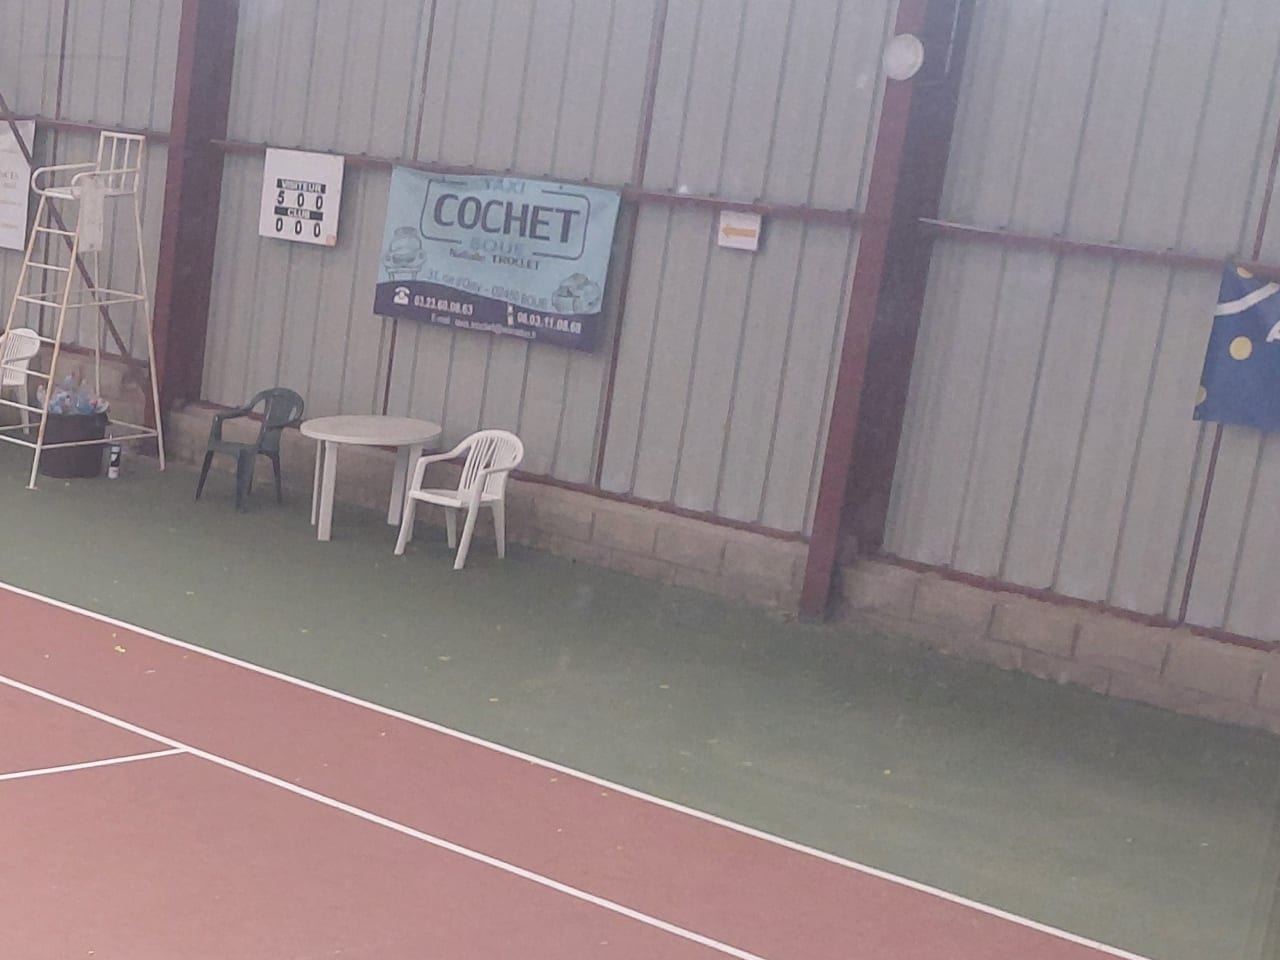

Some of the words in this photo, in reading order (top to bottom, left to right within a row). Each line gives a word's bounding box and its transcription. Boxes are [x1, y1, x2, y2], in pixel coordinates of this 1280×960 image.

[484, 178, 527, 194] TAXI
[276, 190, 285, 205] 5
[297, 193, 305, 208] 0
[315, 195, 324, 210] 0
[287, 208, 311, 220] CLUB
[433, 193, 580, 243] COCHET
[275, 217, 284, 233] 0
[294, 220, 303, 235] 0
[313, 222, 322, 238] 0
